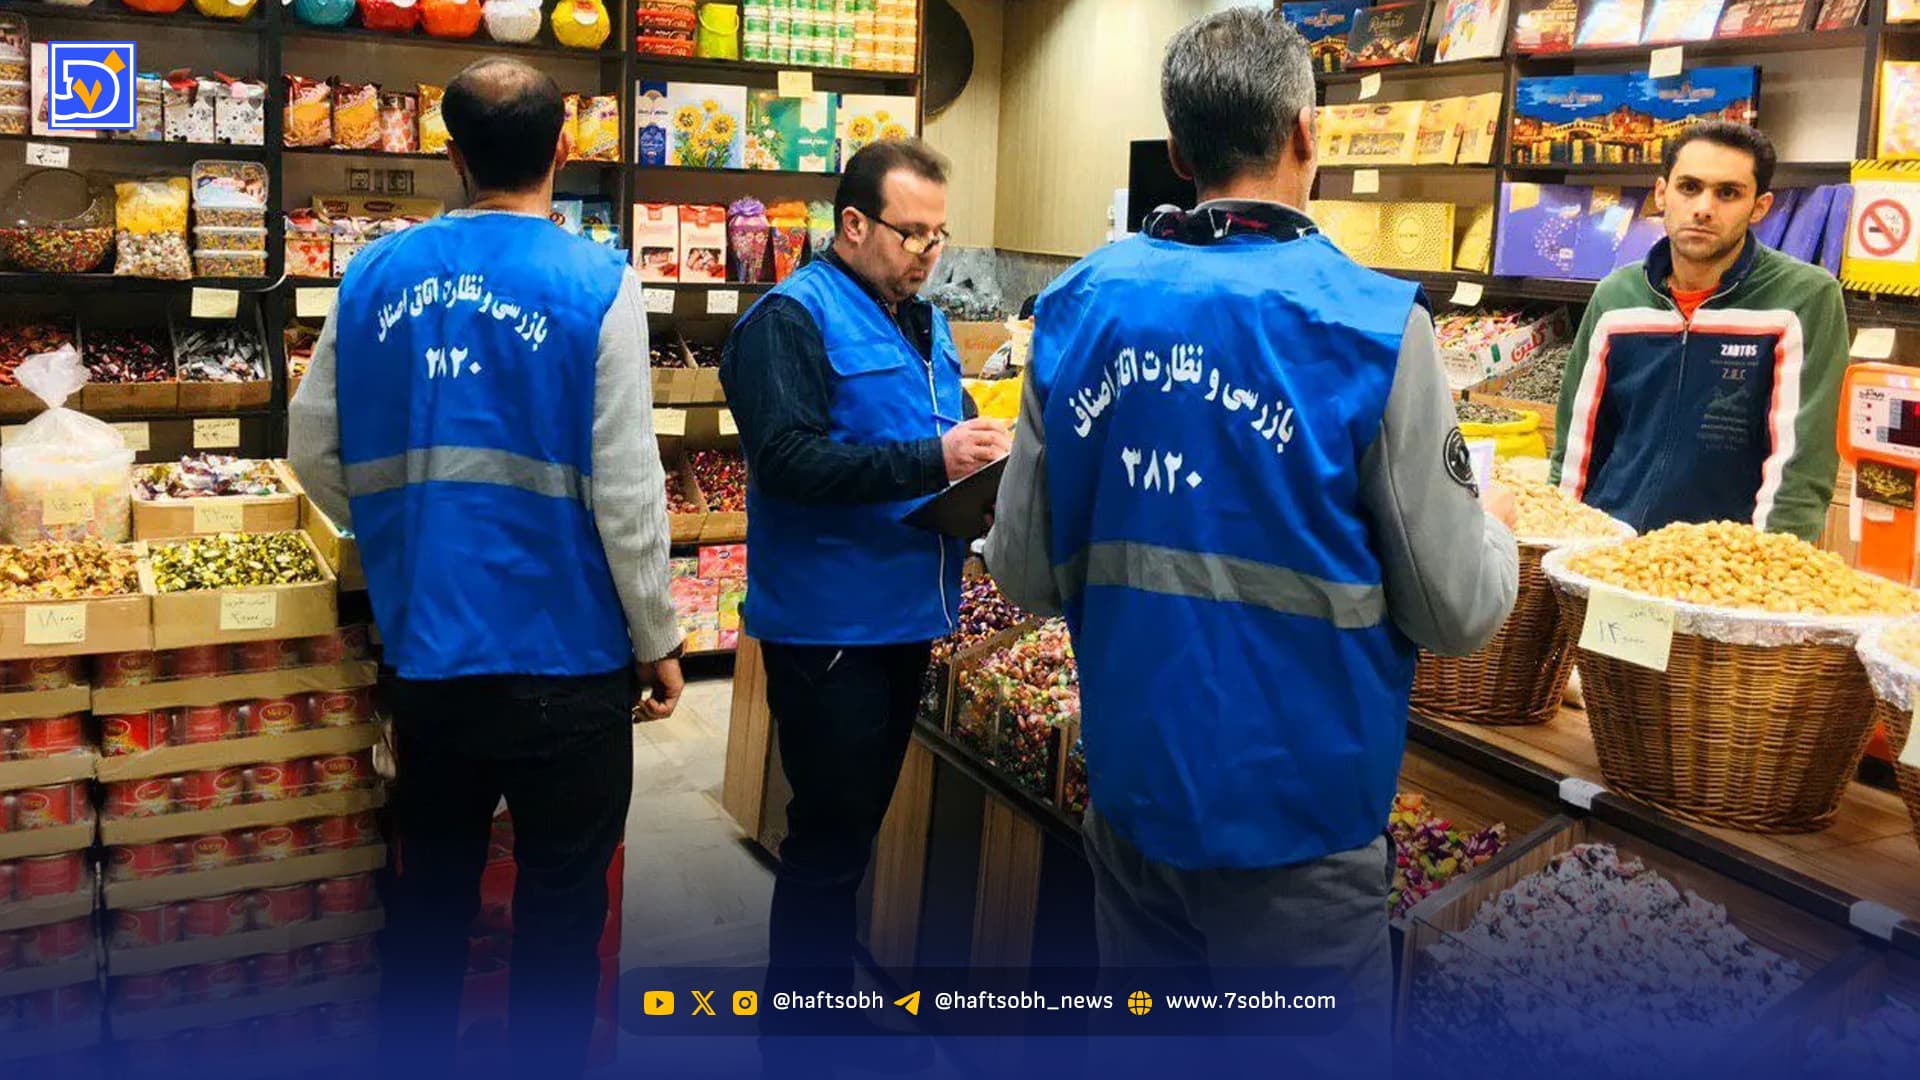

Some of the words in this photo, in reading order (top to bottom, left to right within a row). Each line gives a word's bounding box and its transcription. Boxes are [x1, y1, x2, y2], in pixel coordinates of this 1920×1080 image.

[409, 277, 439, 317] اتاق
[442, 273, 484, 308] نظارت
[478, 291, 493, 313] و
[377, 288, 408, 343] اصناف
[491, 300, 548, 352] بازرسی
[425, 347, 482, 380] ۳۸۲۰
[1142, 343, 1204, 393] نظارت
[1204, 367, 1220, 401] و
[1068, 363, 1116, 438] اصناف
[1222, 383, 1294, 454] بازرسی
[1121, 446, 1203, 495] ۳۸۲۰
